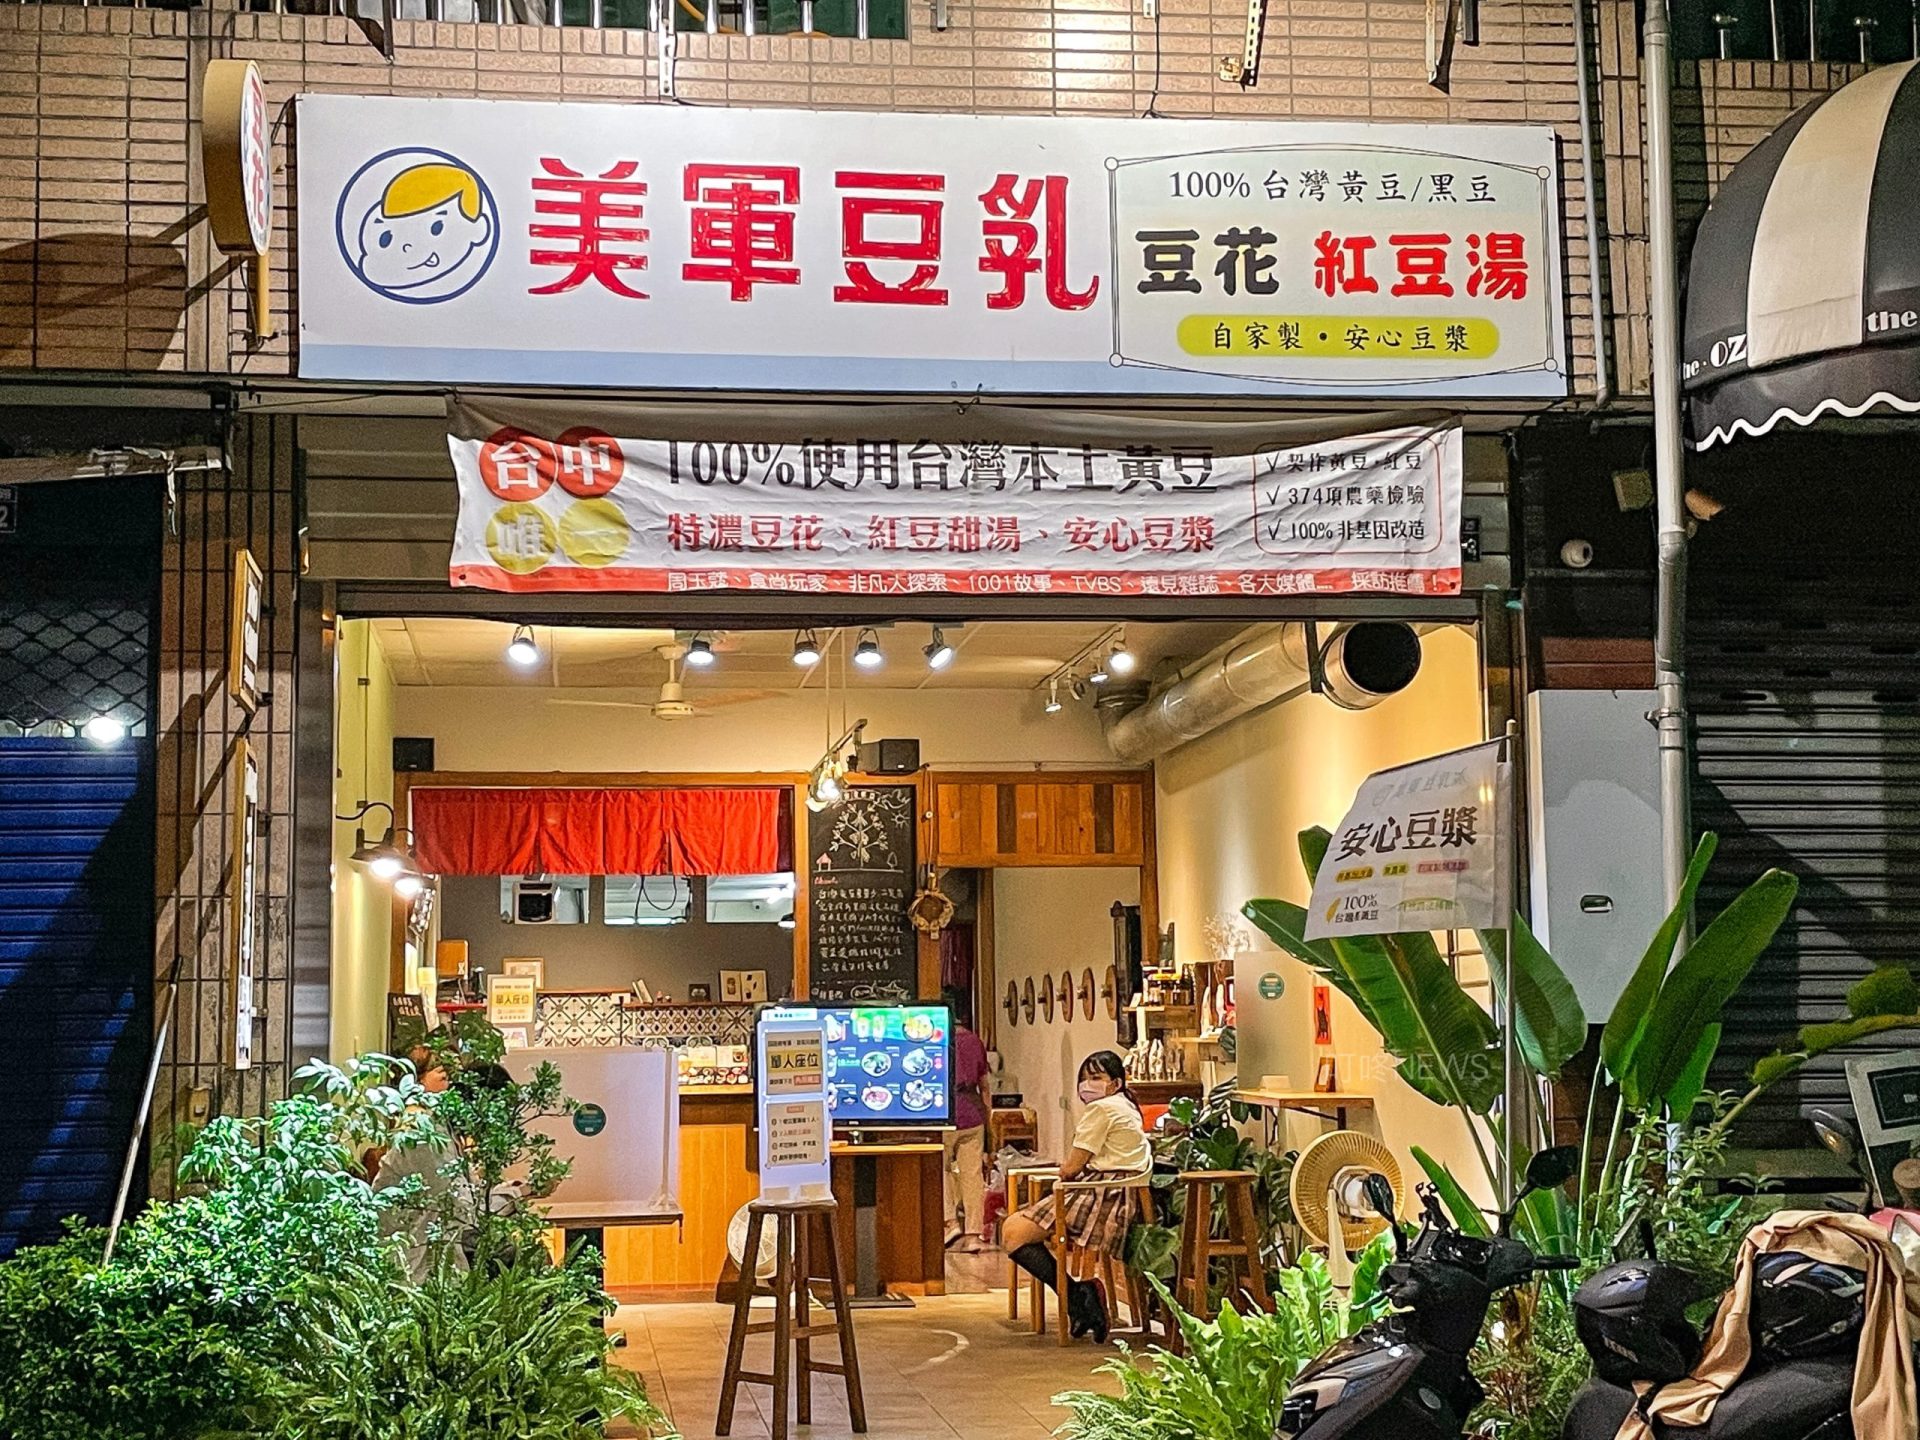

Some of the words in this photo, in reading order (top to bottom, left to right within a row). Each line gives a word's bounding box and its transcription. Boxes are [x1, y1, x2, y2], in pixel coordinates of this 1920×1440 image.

[1169, 170, 1250, 200] 100%
[1263, 170, 1497, 205] 台灣黃豆/黑豆
[528, 156, 1098, 311] 美軍豆乳
[1136, 226, 1281, 298] 豆花
[1313, 229, 1529, 300] 紅豆湯
[1864, 310, 1918, 333] the
[489, 438, 612, 491] 台中
[667, 438, 1217, 493] 100%使用台灣本土黃豆
[1288, 484, 1425, 506] 374項農藥檢驗
[496, 513, 611, 560] 唯一
[667, 512, 1215, 553] 特濃豆花、紅豆甜湯、安心豆漿
[1334, 806, 1479, 862] 安心豆漿
